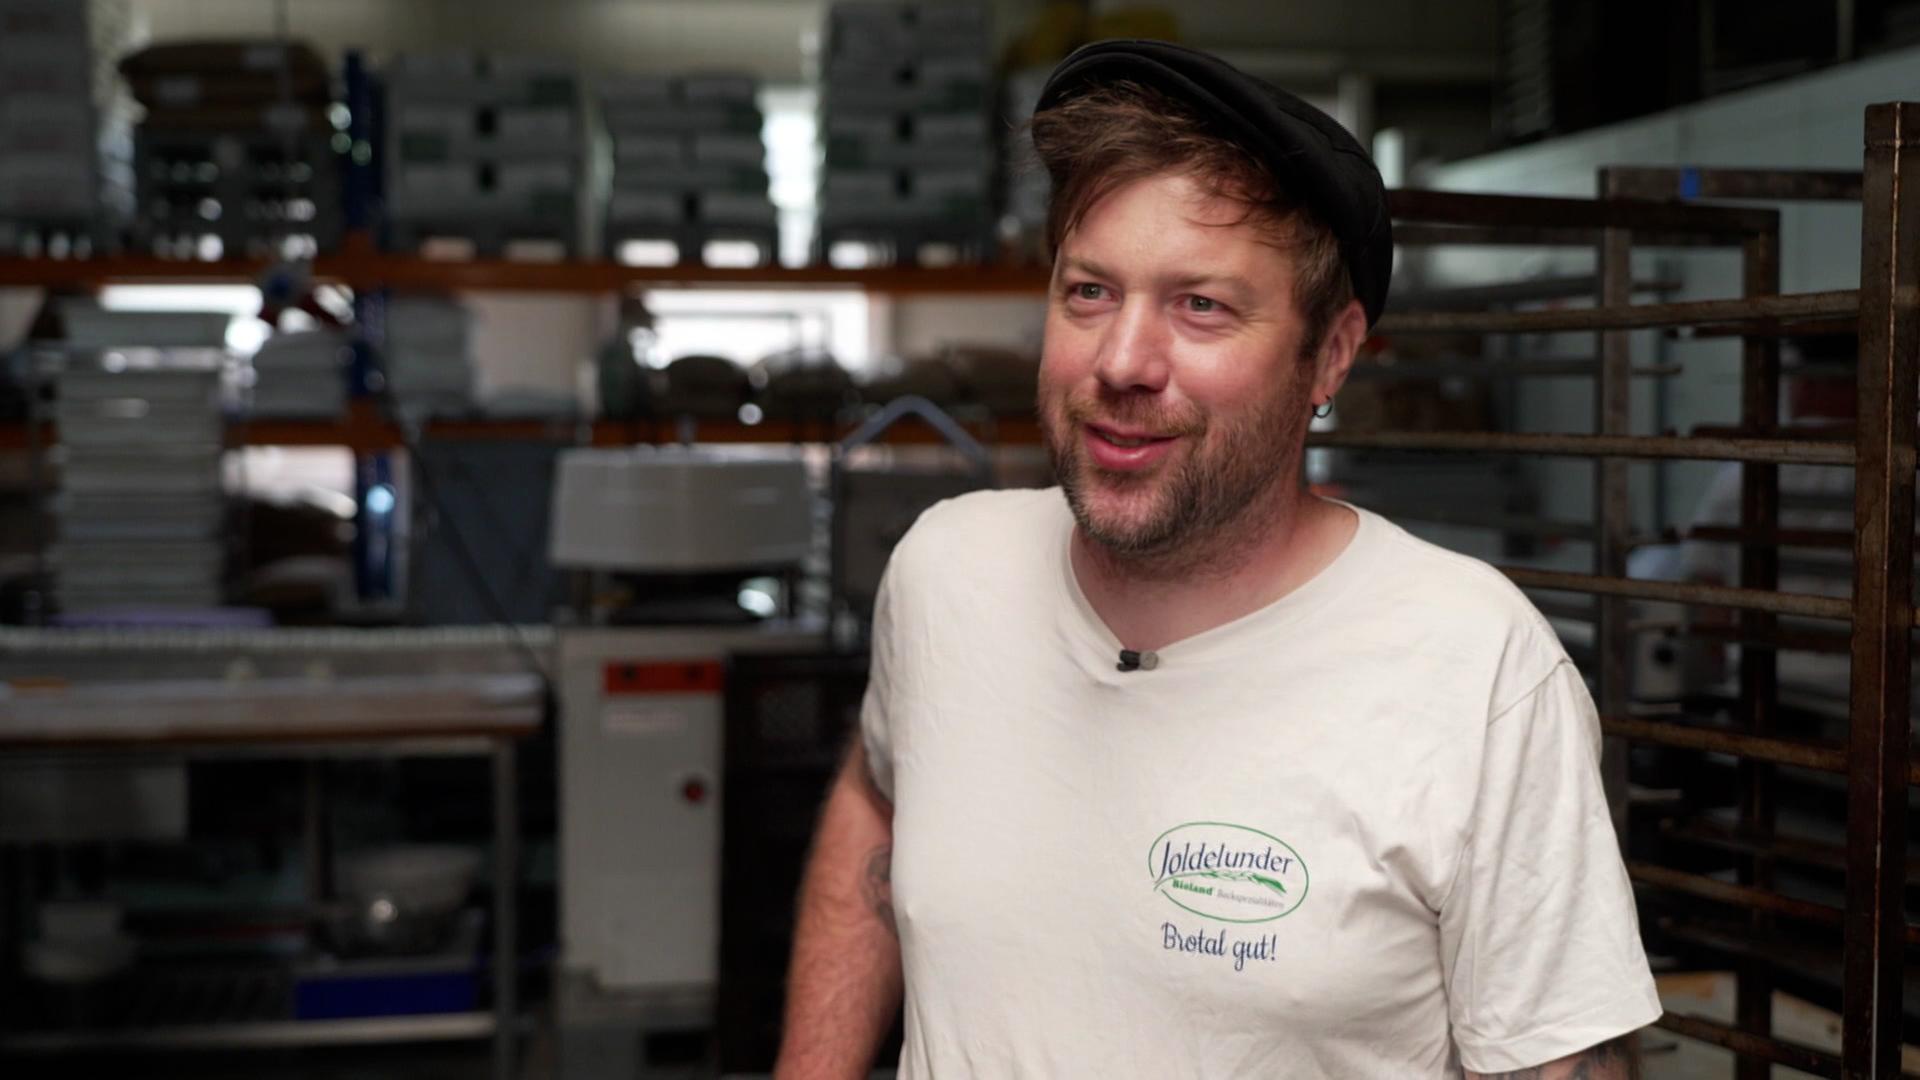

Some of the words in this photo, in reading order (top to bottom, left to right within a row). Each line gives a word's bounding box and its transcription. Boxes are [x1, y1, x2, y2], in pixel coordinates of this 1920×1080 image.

[1155, 841, 1293, 884] Joldelunder
[1171, 879, 1213, 896] Bioland
[1161, 921, 1226, 956] Brotal
[1232, 934, 1277, 972] gut!
